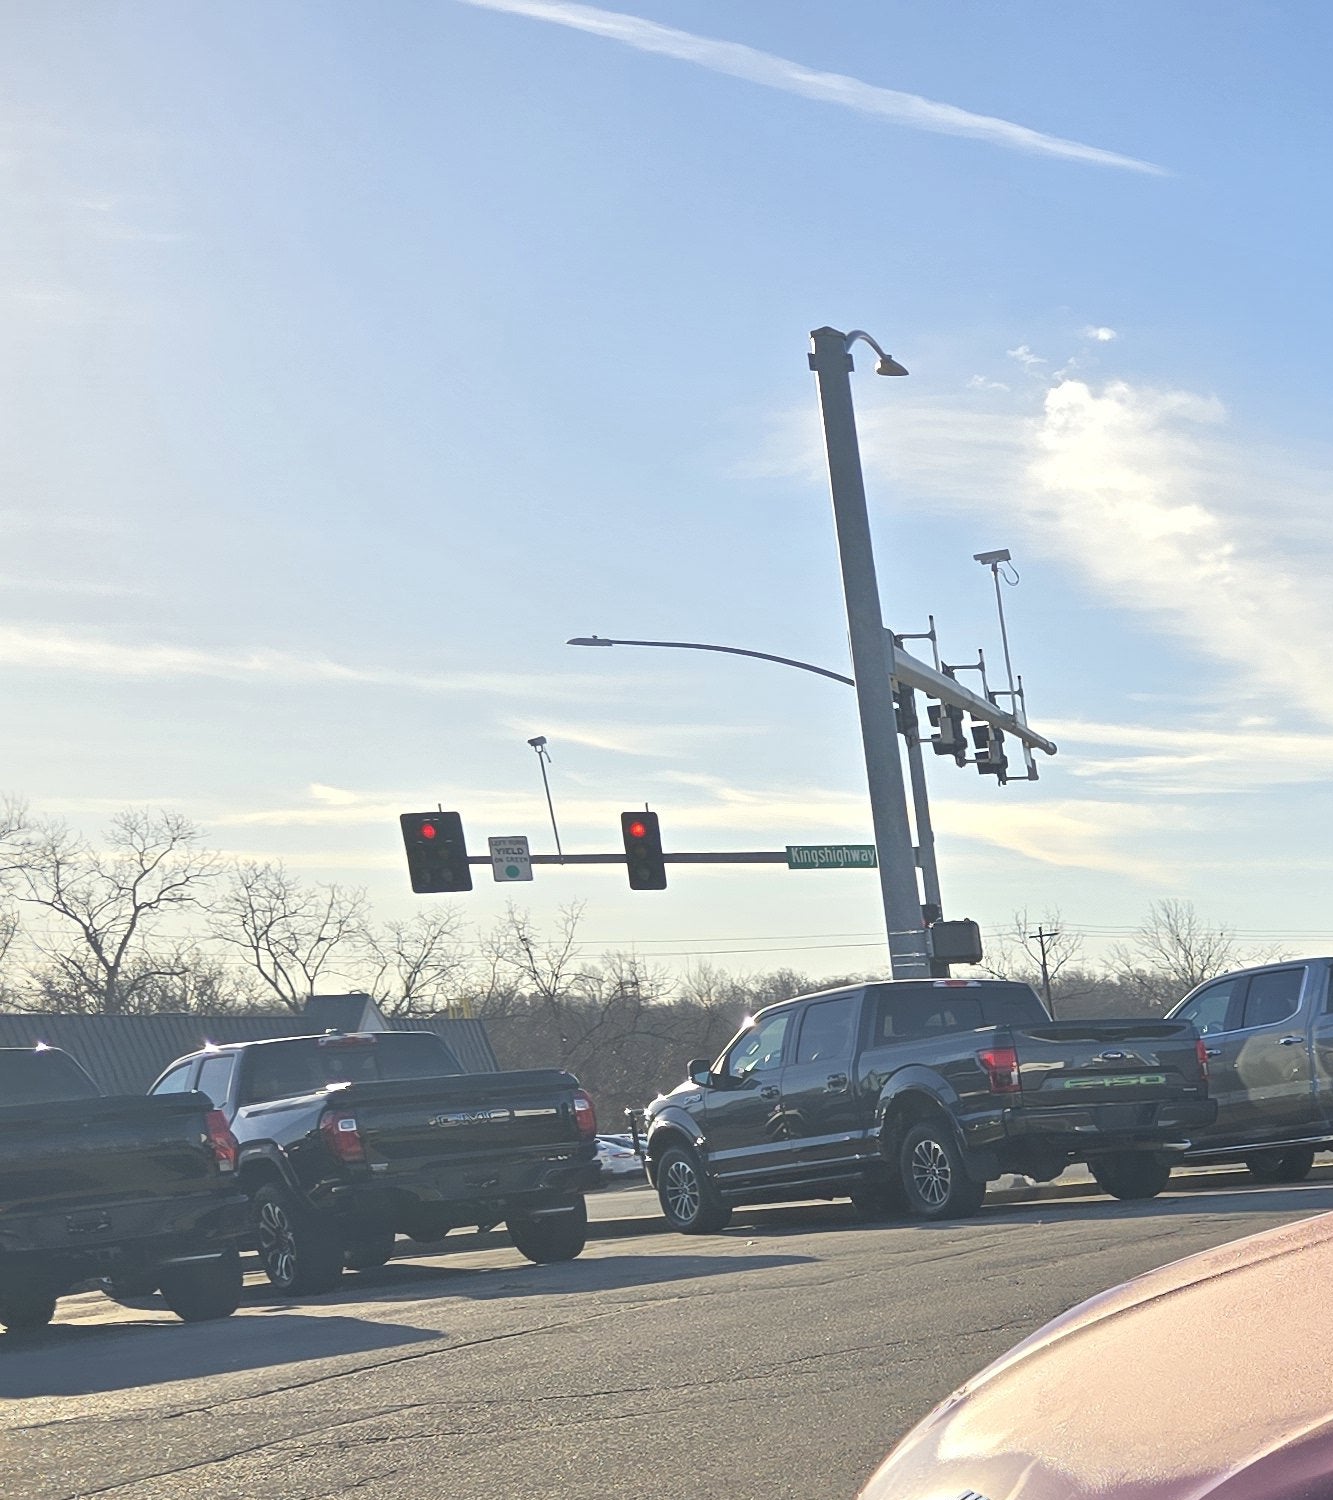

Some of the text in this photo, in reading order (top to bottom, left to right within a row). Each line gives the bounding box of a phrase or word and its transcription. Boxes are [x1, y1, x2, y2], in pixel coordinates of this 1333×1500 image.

[495, 847, 524, 855] YIELD
[791, 846, 875, 867] Kingshighway
[435, 1108, 511, 1128] GMC
